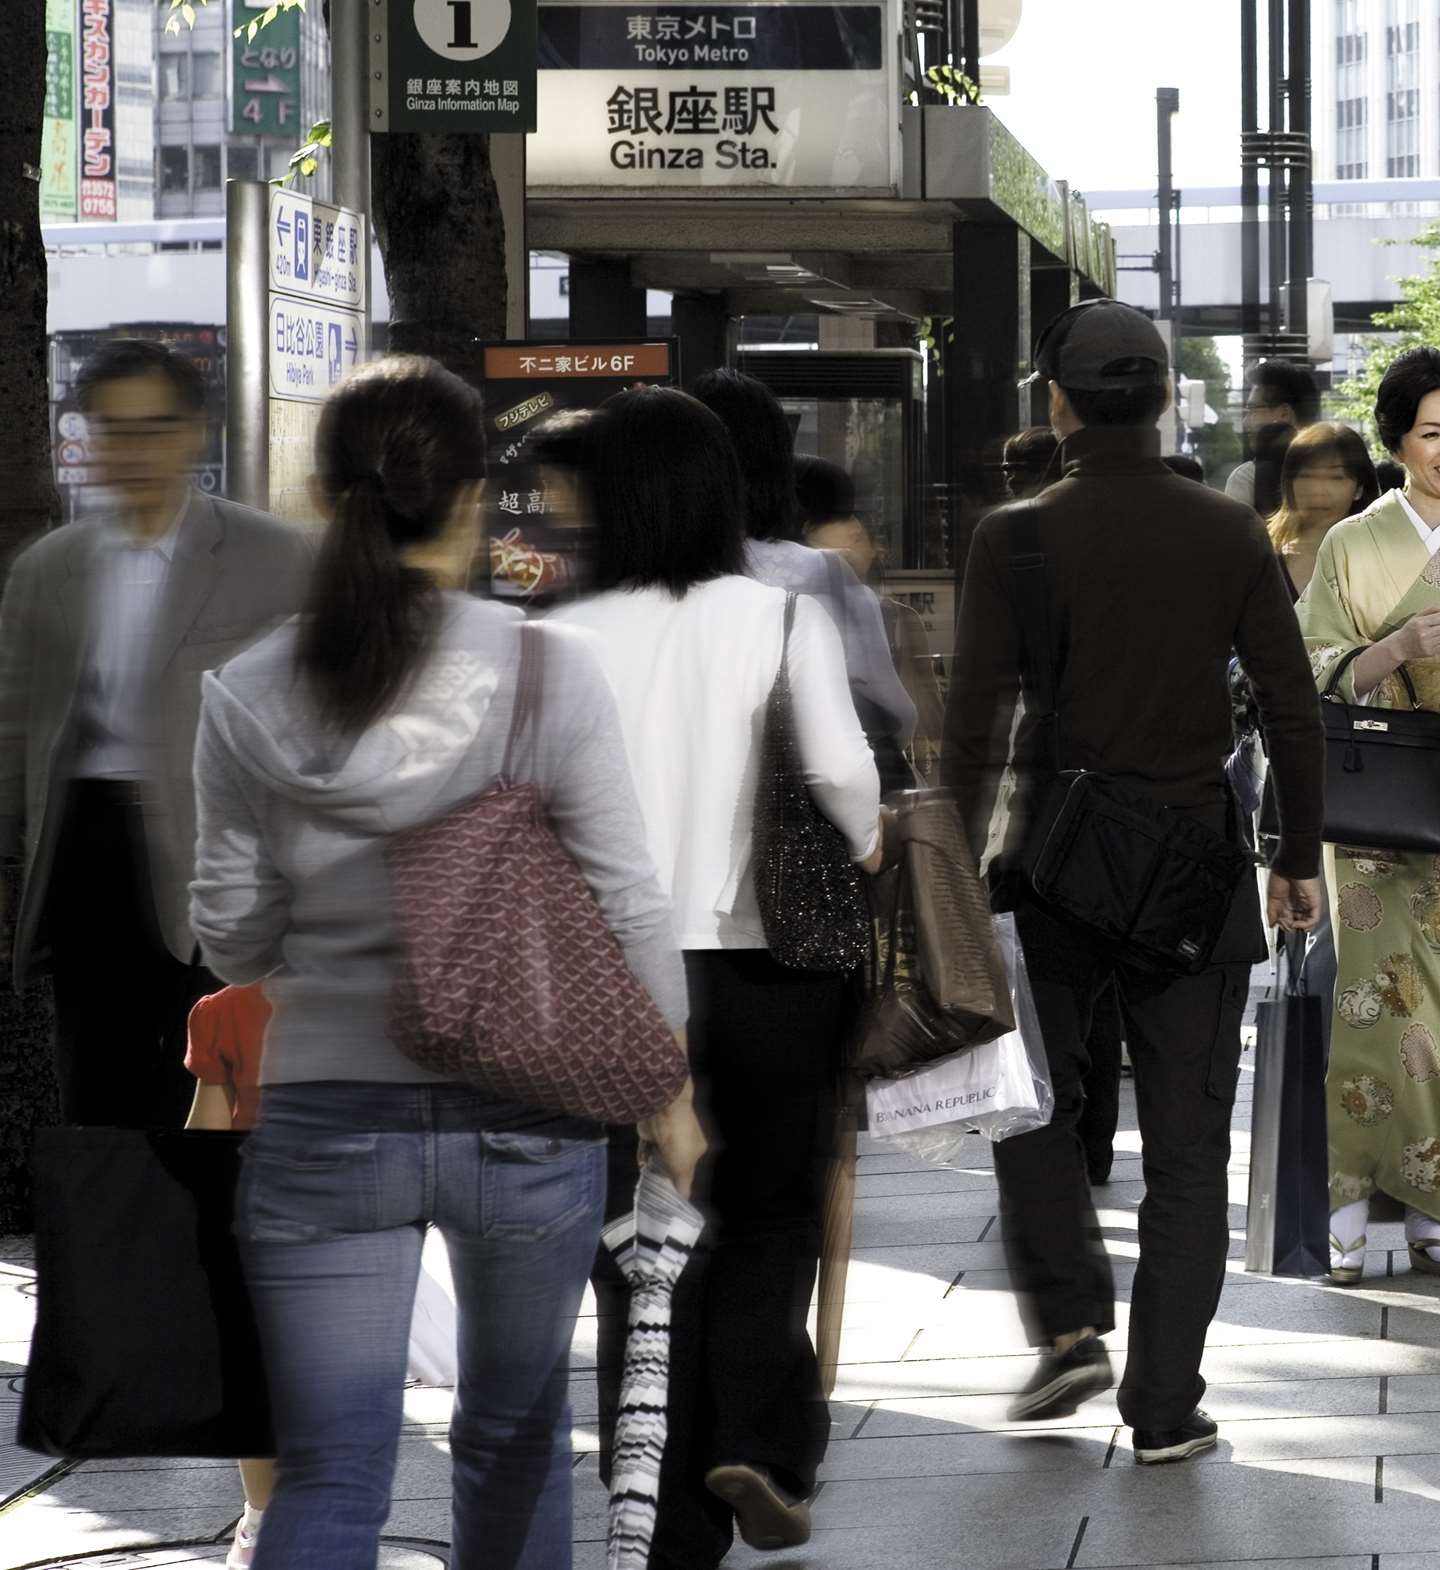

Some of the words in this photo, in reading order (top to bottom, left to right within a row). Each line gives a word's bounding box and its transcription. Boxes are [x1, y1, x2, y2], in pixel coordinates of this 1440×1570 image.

[626, 15, 757, 40] 東京メトロ
[241, 47, 297, 70] となり
[635, 44, 690, 66] Tokyo
[694, 44, 749, 62] Metro
[406, 78, 519, 96] 銀座案内地図
[406, 96, 436, 111] Ginza
[438, 97, 496, 112] Information
[497, 98, 520, 115] Map
[605, 85, 780, 136] 銀座駅
[610, 140, 704, 170] Ginza
[715, 140, 778, 170] Sta.
[313, 216, 358, 265] 東銀座駅
[276, 312, 324, 360] 日比谷公園
[519, 354, 636, 374] 不二家ビル6F
[498, 394, 551, 430] フジテレビ
[875, 1102, 932, 1124] BANANA
[934, 1085, 997, 1111] REPUBLIC
